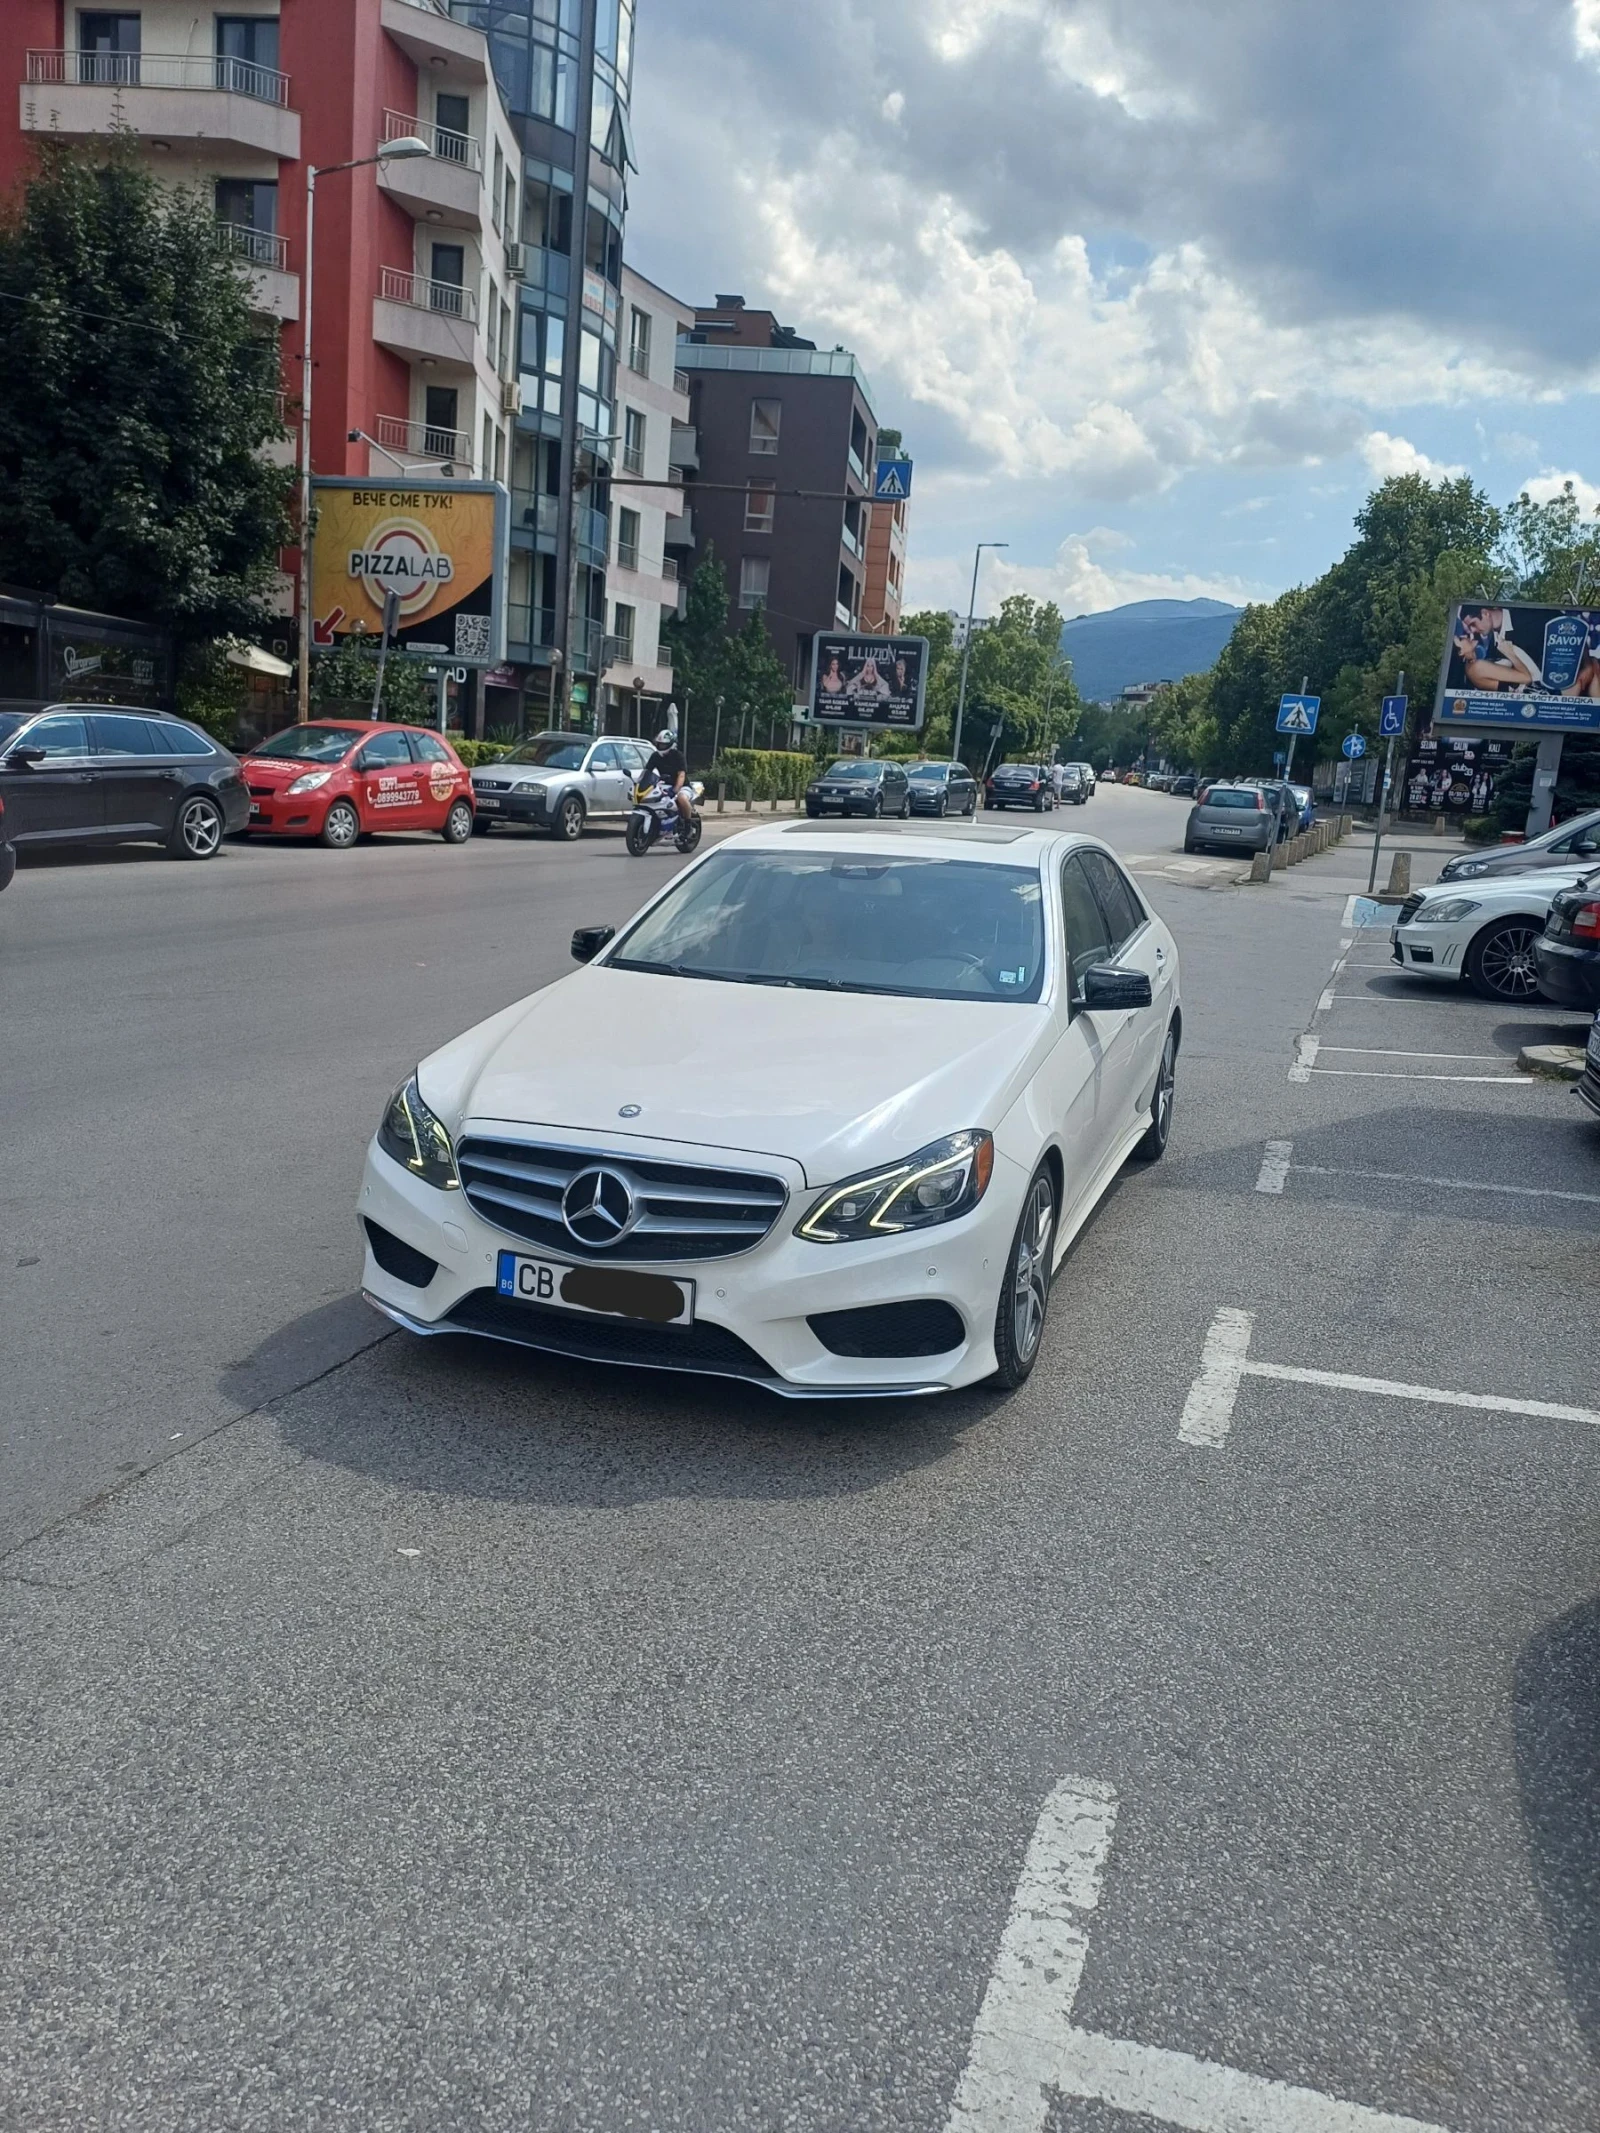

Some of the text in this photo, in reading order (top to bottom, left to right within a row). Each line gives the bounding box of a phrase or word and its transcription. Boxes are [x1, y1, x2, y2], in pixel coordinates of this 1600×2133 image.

[353, 492, 453, 509] ВЕЧЕ СМЕ ТУК!
[351, 553, 451, 579] PIZZALAB
[1547, 634, 1583, 646] SAVOY
[848, 643, 897, 663] ILLUZION
[1454, 690, 1594, 705] МРЪСНИ ТАНЦИ ЧИСТА ВОДКА
[377, 790, 420, 803] 0899943779
[501, 1279, 513, 1290] BG
[518, 1263, 554, 1299] CB
